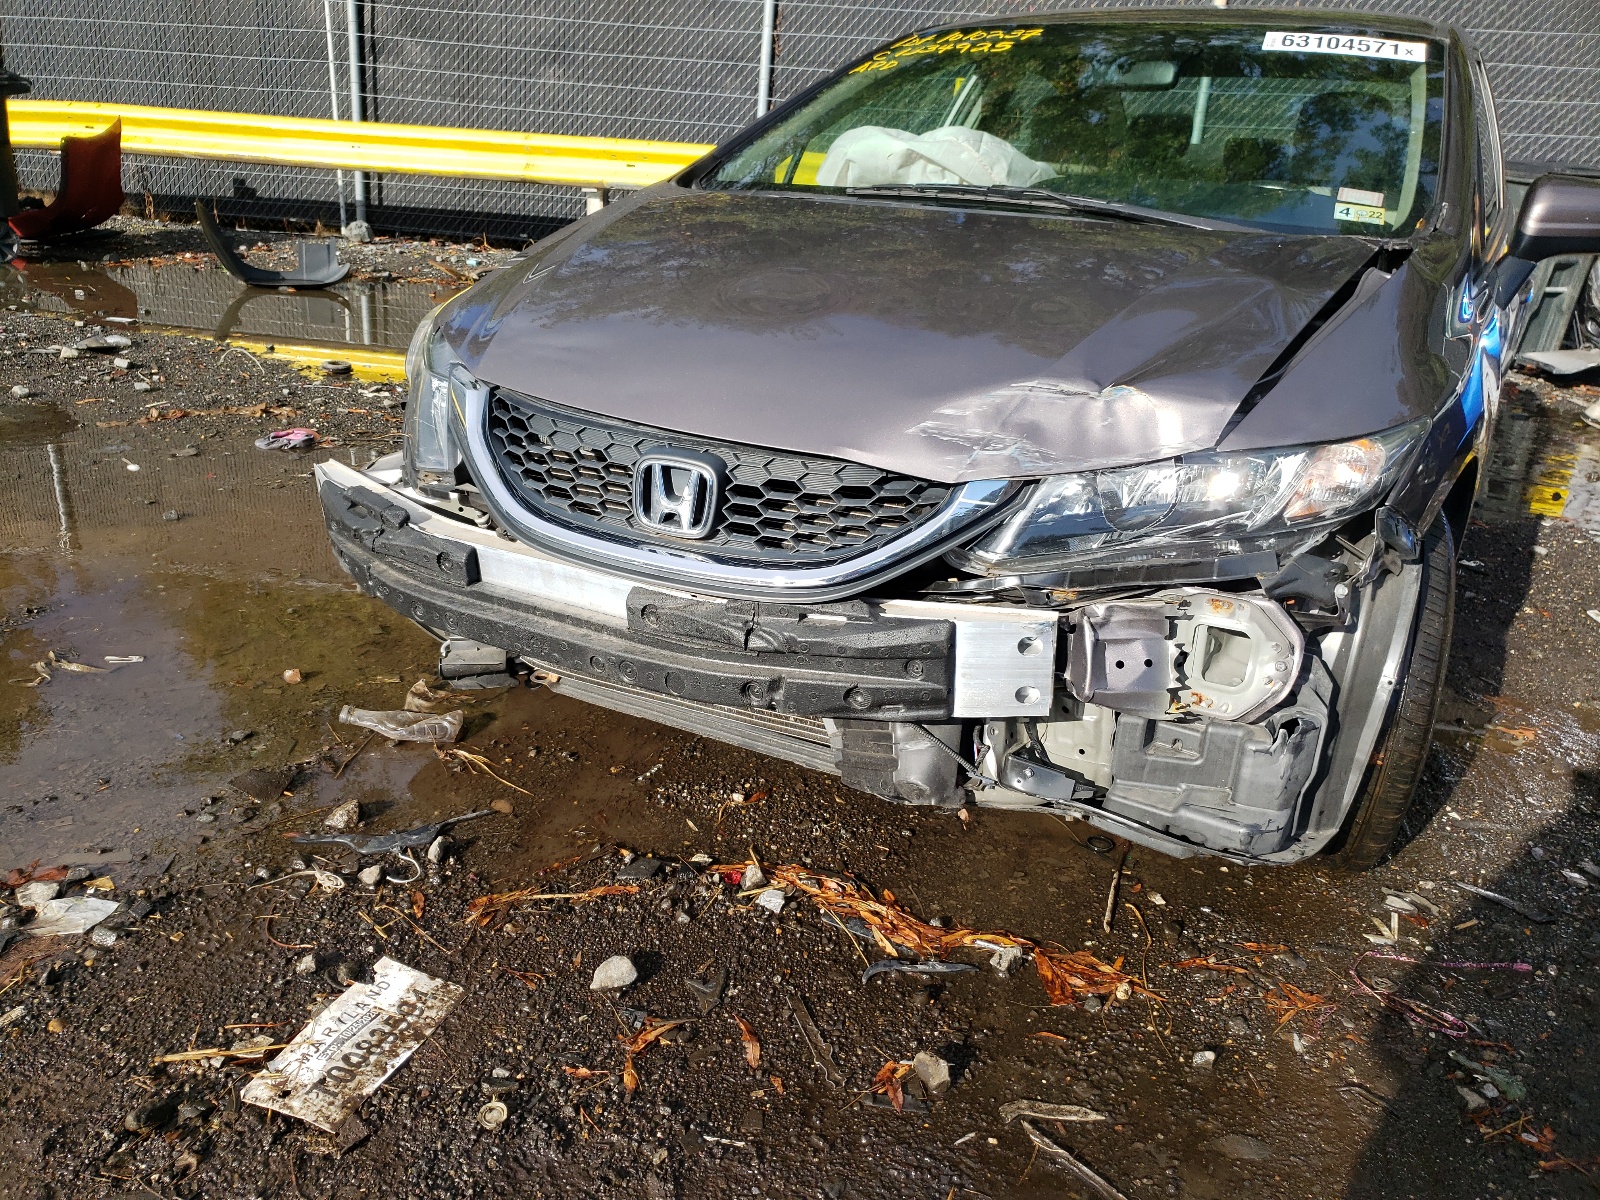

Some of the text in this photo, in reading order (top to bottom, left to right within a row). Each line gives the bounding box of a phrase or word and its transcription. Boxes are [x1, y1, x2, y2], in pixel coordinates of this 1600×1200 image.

[1281, 34, 1400, 56] 63104571
[1338, 207, 1351, 217] 4
[1368, 210, 1383, 220] 22
